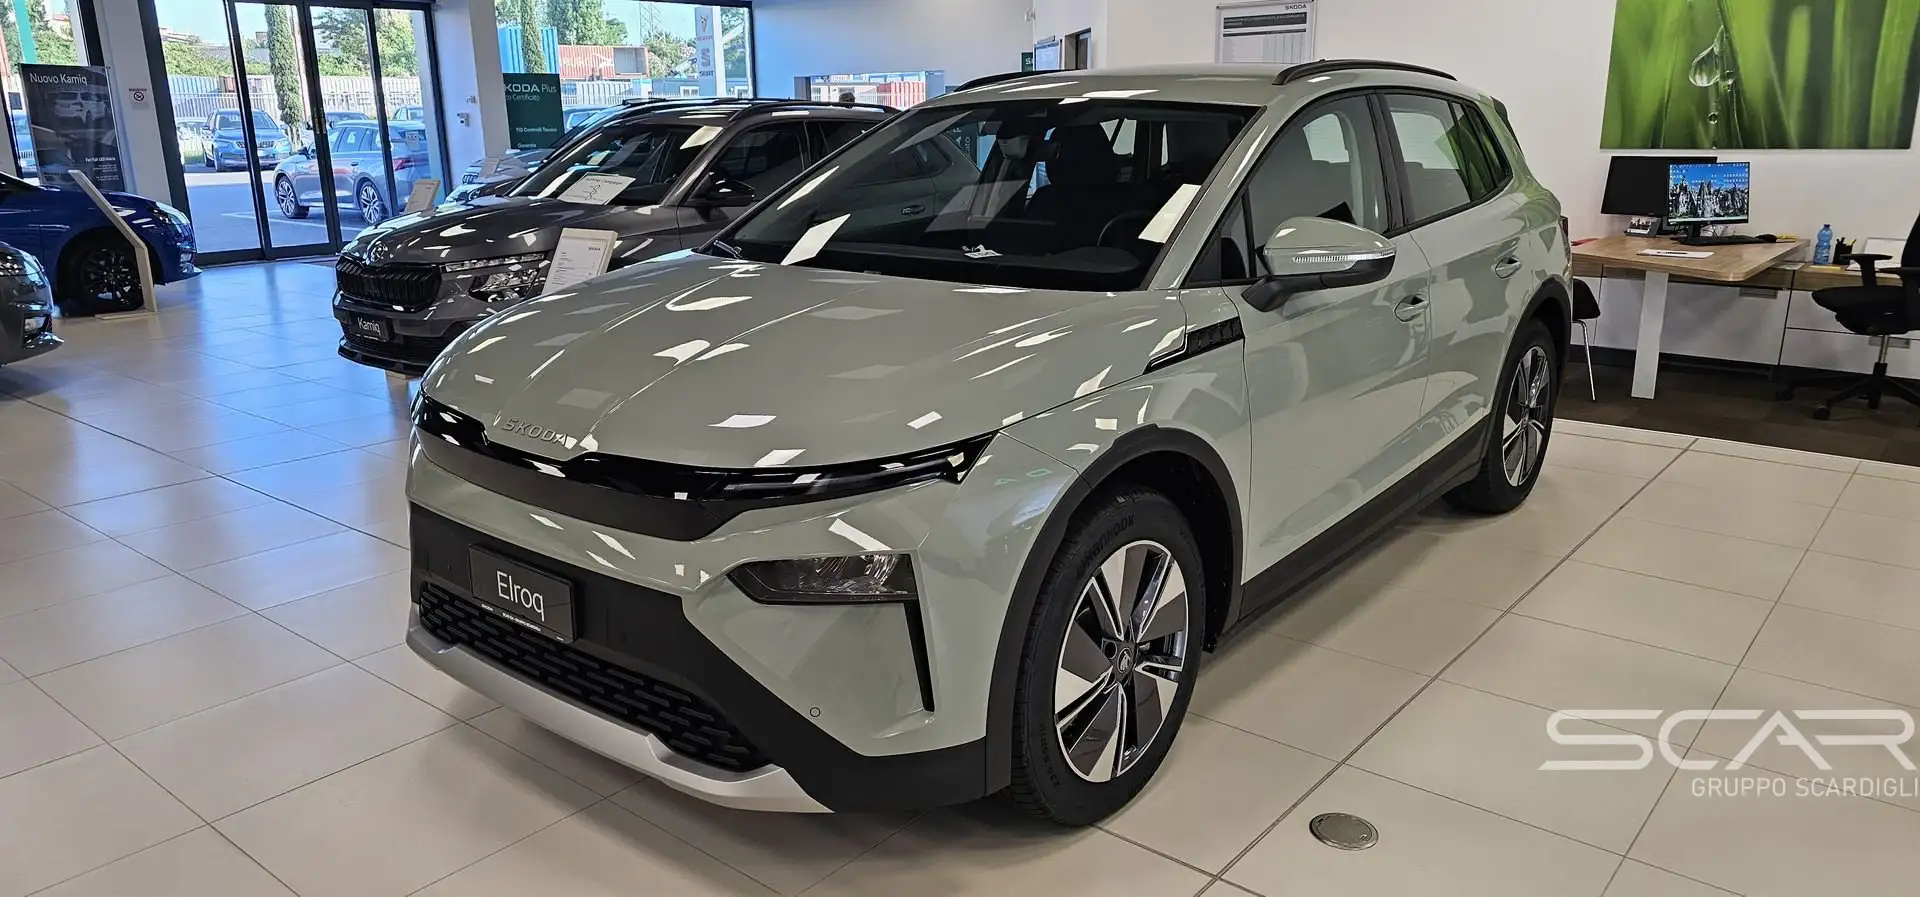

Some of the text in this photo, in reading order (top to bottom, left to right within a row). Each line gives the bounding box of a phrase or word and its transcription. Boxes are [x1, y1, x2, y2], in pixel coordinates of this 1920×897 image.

[30, 73, 88, 86] Nuovo Kamiq
[505, 83, 557, 93] KODA Plus
[357, 316, 382, 336] Kamiq
[502, 417, 570, 447] SKODA
[496, 570, 545, 622] Elroq
